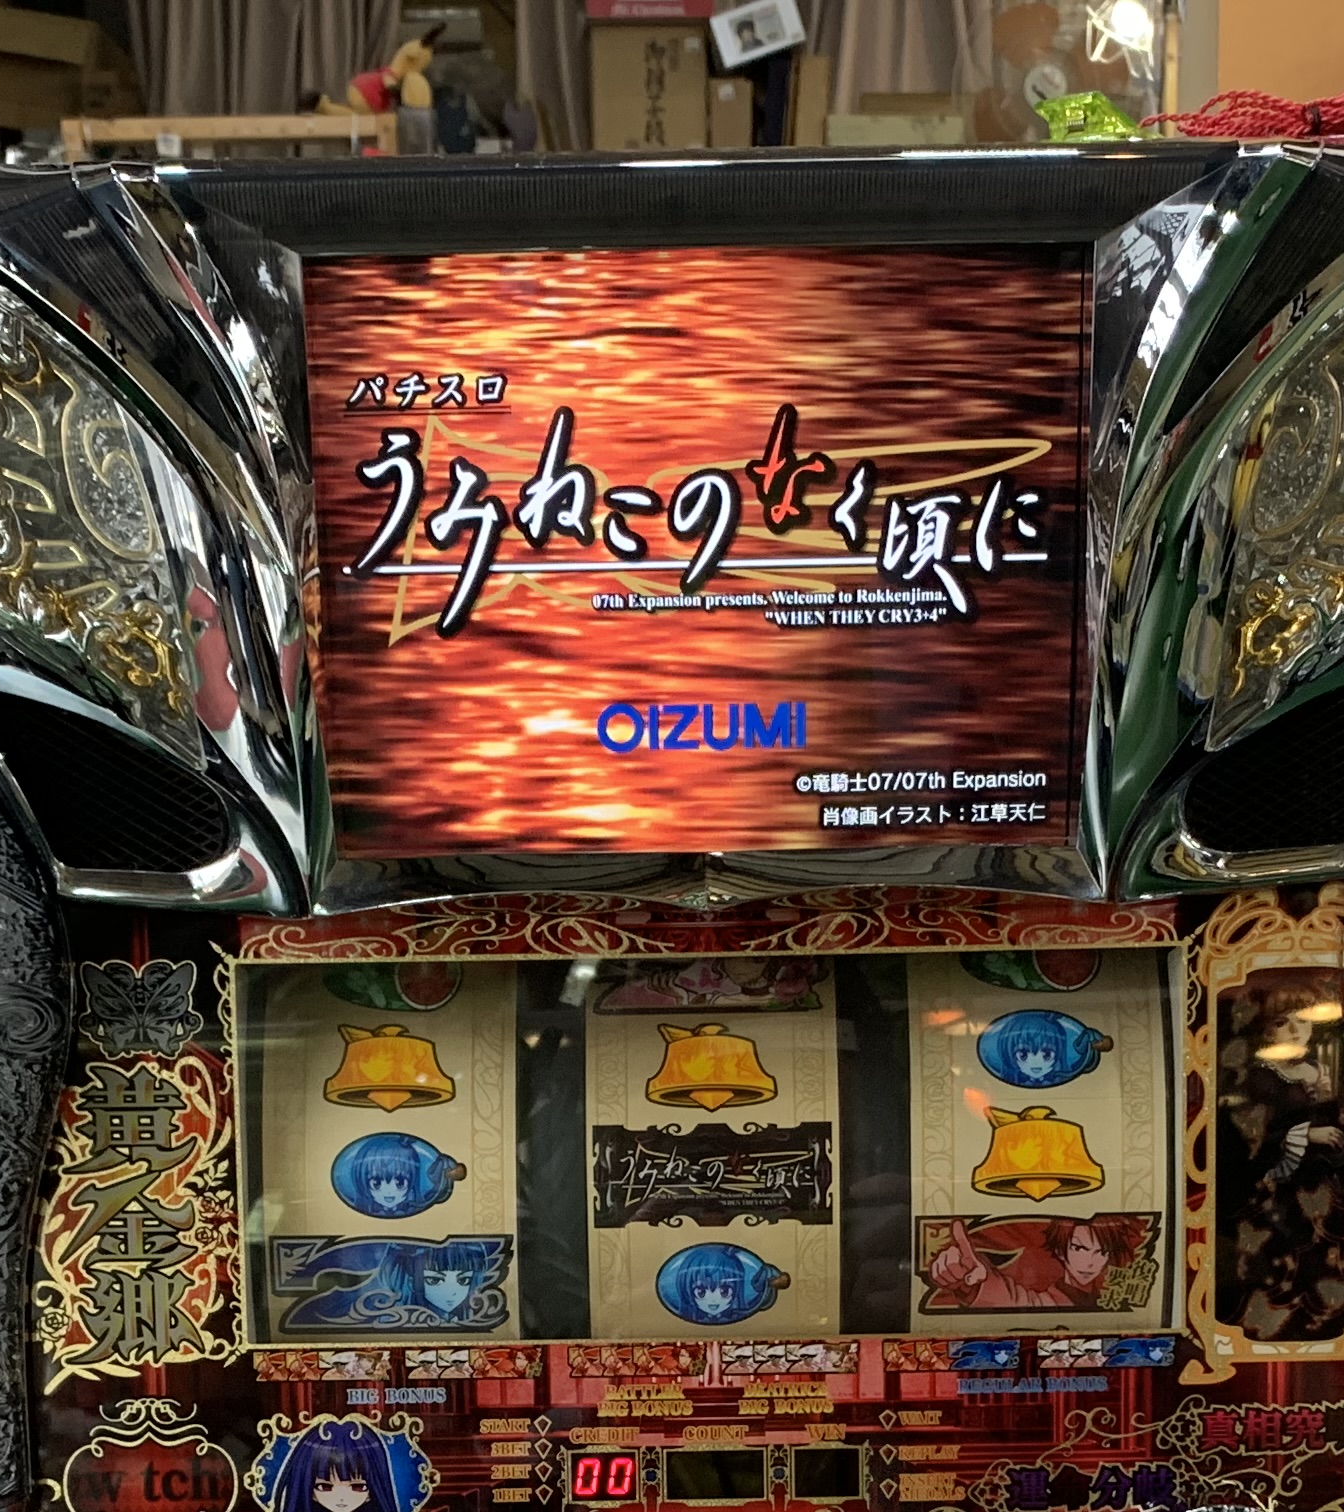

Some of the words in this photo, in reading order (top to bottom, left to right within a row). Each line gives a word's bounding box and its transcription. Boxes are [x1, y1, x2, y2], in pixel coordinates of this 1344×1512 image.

[347, 374, 507, 406] パチスロ
[348, 406, 1041, 630] うみねこのなく頃に
[593, 592, 625, 610] 07th
[627, 592, 703, 613] Expansion
[771, 589, 835, 608] Welcome
[838, 590, 854, 608] to
[856, 588, 947, 610] Rokkenjima.
[765, 609, 826, 627] "WHEN
[829, 608, 877, 627] THEY
[596, 701, 807, 752] OIZUMI
[952, 769, 1046, 791] Expansion
[63, 1064, 204, 1365] 黄金郷
[347, 1387, 379, 1404] BIG
[384, 1387, 447, 1404] BONUS
[738, 1399, 771, 1416] BIG
[774, 1398, 835, 1415] BONUS
[479, 1418, 531, 1435] START
[897, 1410, 943, 1427] WAIT
[569, 1427, 640, 1444] CREDIT
[683, 1425, 749, 1442] COUNT
[805, 1424, 847, 1441] WIN
[491, 1464, 532, 1480] 2BET
[576, 1457, 634, 1495] 00
[492, 1487, 532, 1503] 1BET
